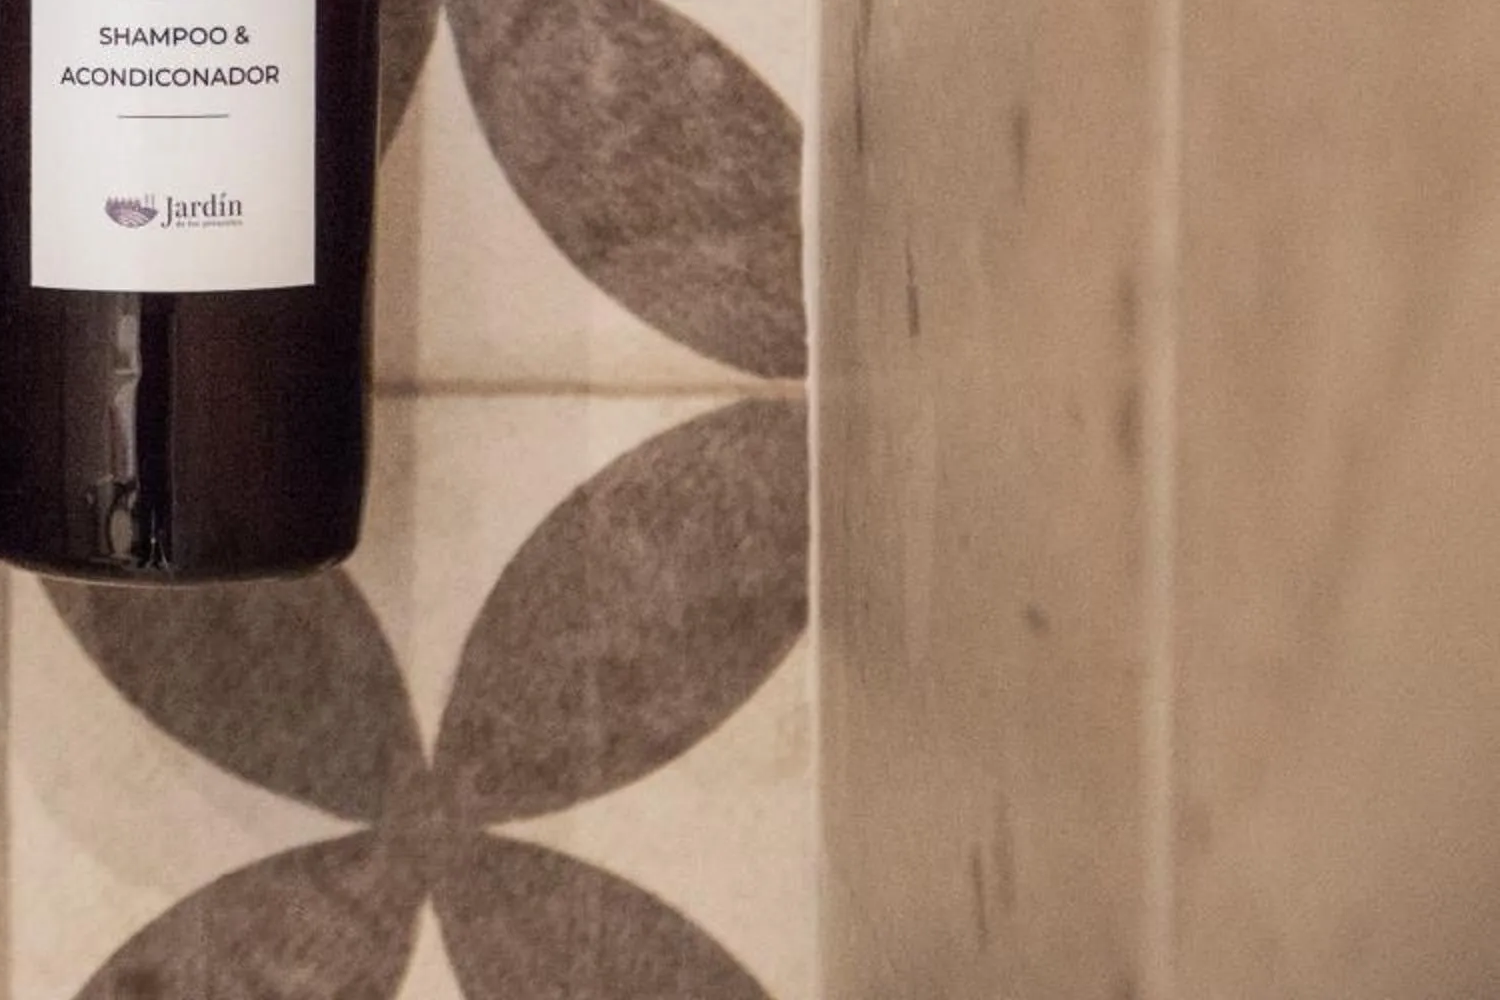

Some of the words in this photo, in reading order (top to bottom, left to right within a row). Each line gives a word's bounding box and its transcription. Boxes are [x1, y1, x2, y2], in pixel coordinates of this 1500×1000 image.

[99, 26, 228, 47] SHAMPOO
[234, 25, 250, 46] &
[60, 65, 280, 87] ACONDICONADOR
[160, 192, 243, 228] Jardín
